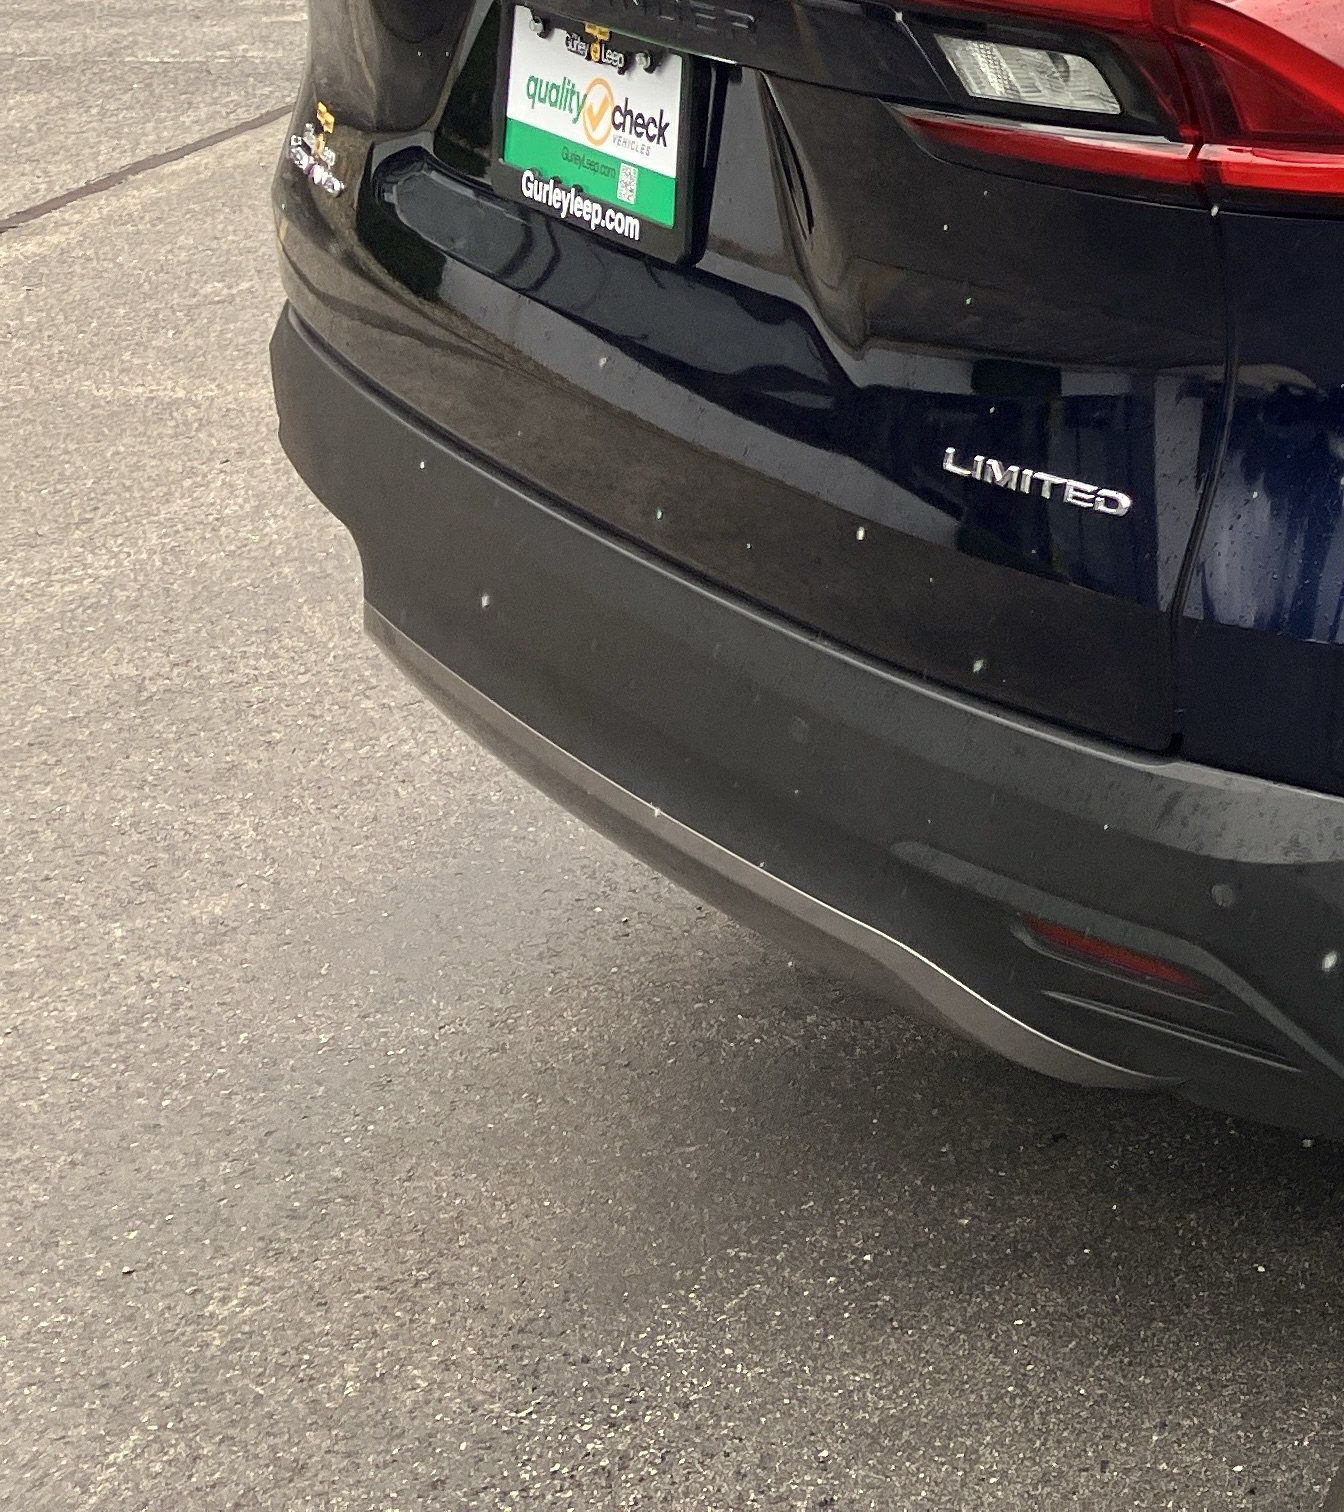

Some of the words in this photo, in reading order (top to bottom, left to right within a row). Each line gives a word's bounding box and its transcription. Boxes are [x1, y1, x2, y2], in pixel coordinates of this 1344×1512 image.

[526, 74, 587, 124] quality
[611, 97, 670, 148] check
[612, 134, 651, 157] VEHICLES
[521, 170, 641, 240] Gurleyleep.com
[942, 446, 1133, 517] LIMITED
